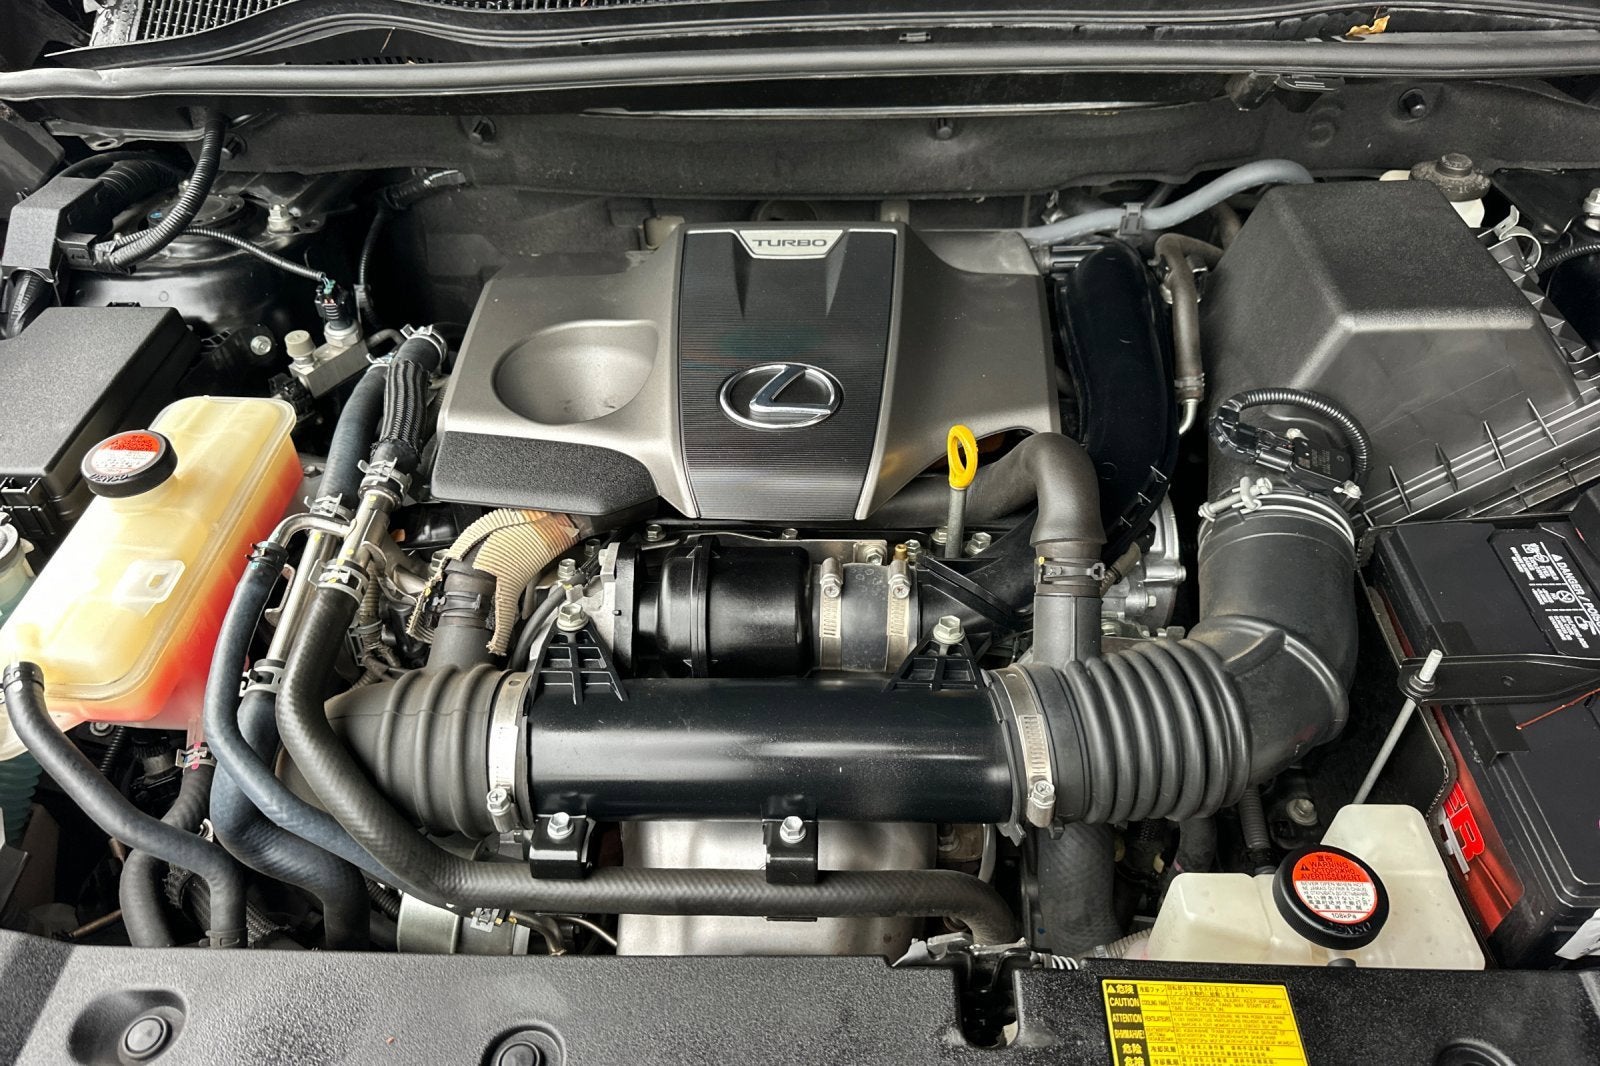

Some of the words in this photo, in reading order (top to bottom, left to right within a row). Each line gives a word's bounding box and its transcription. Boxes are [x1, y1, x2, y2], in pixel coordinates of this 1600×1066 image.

[752, 239, 828, 247] TURBO
[89, 473, 128, 482] DENSO
[1556, 562, 1585, 595] DANGER
[1583, 603, 1600, 628] POIS
[1309, 861, 1349, 869] WARNING
[1116, 984, 1134, 994] 危険
[1109, 997, 1140, 1006] CAUTION
[1112, 1013, 1142, 1023] ATTENTION
